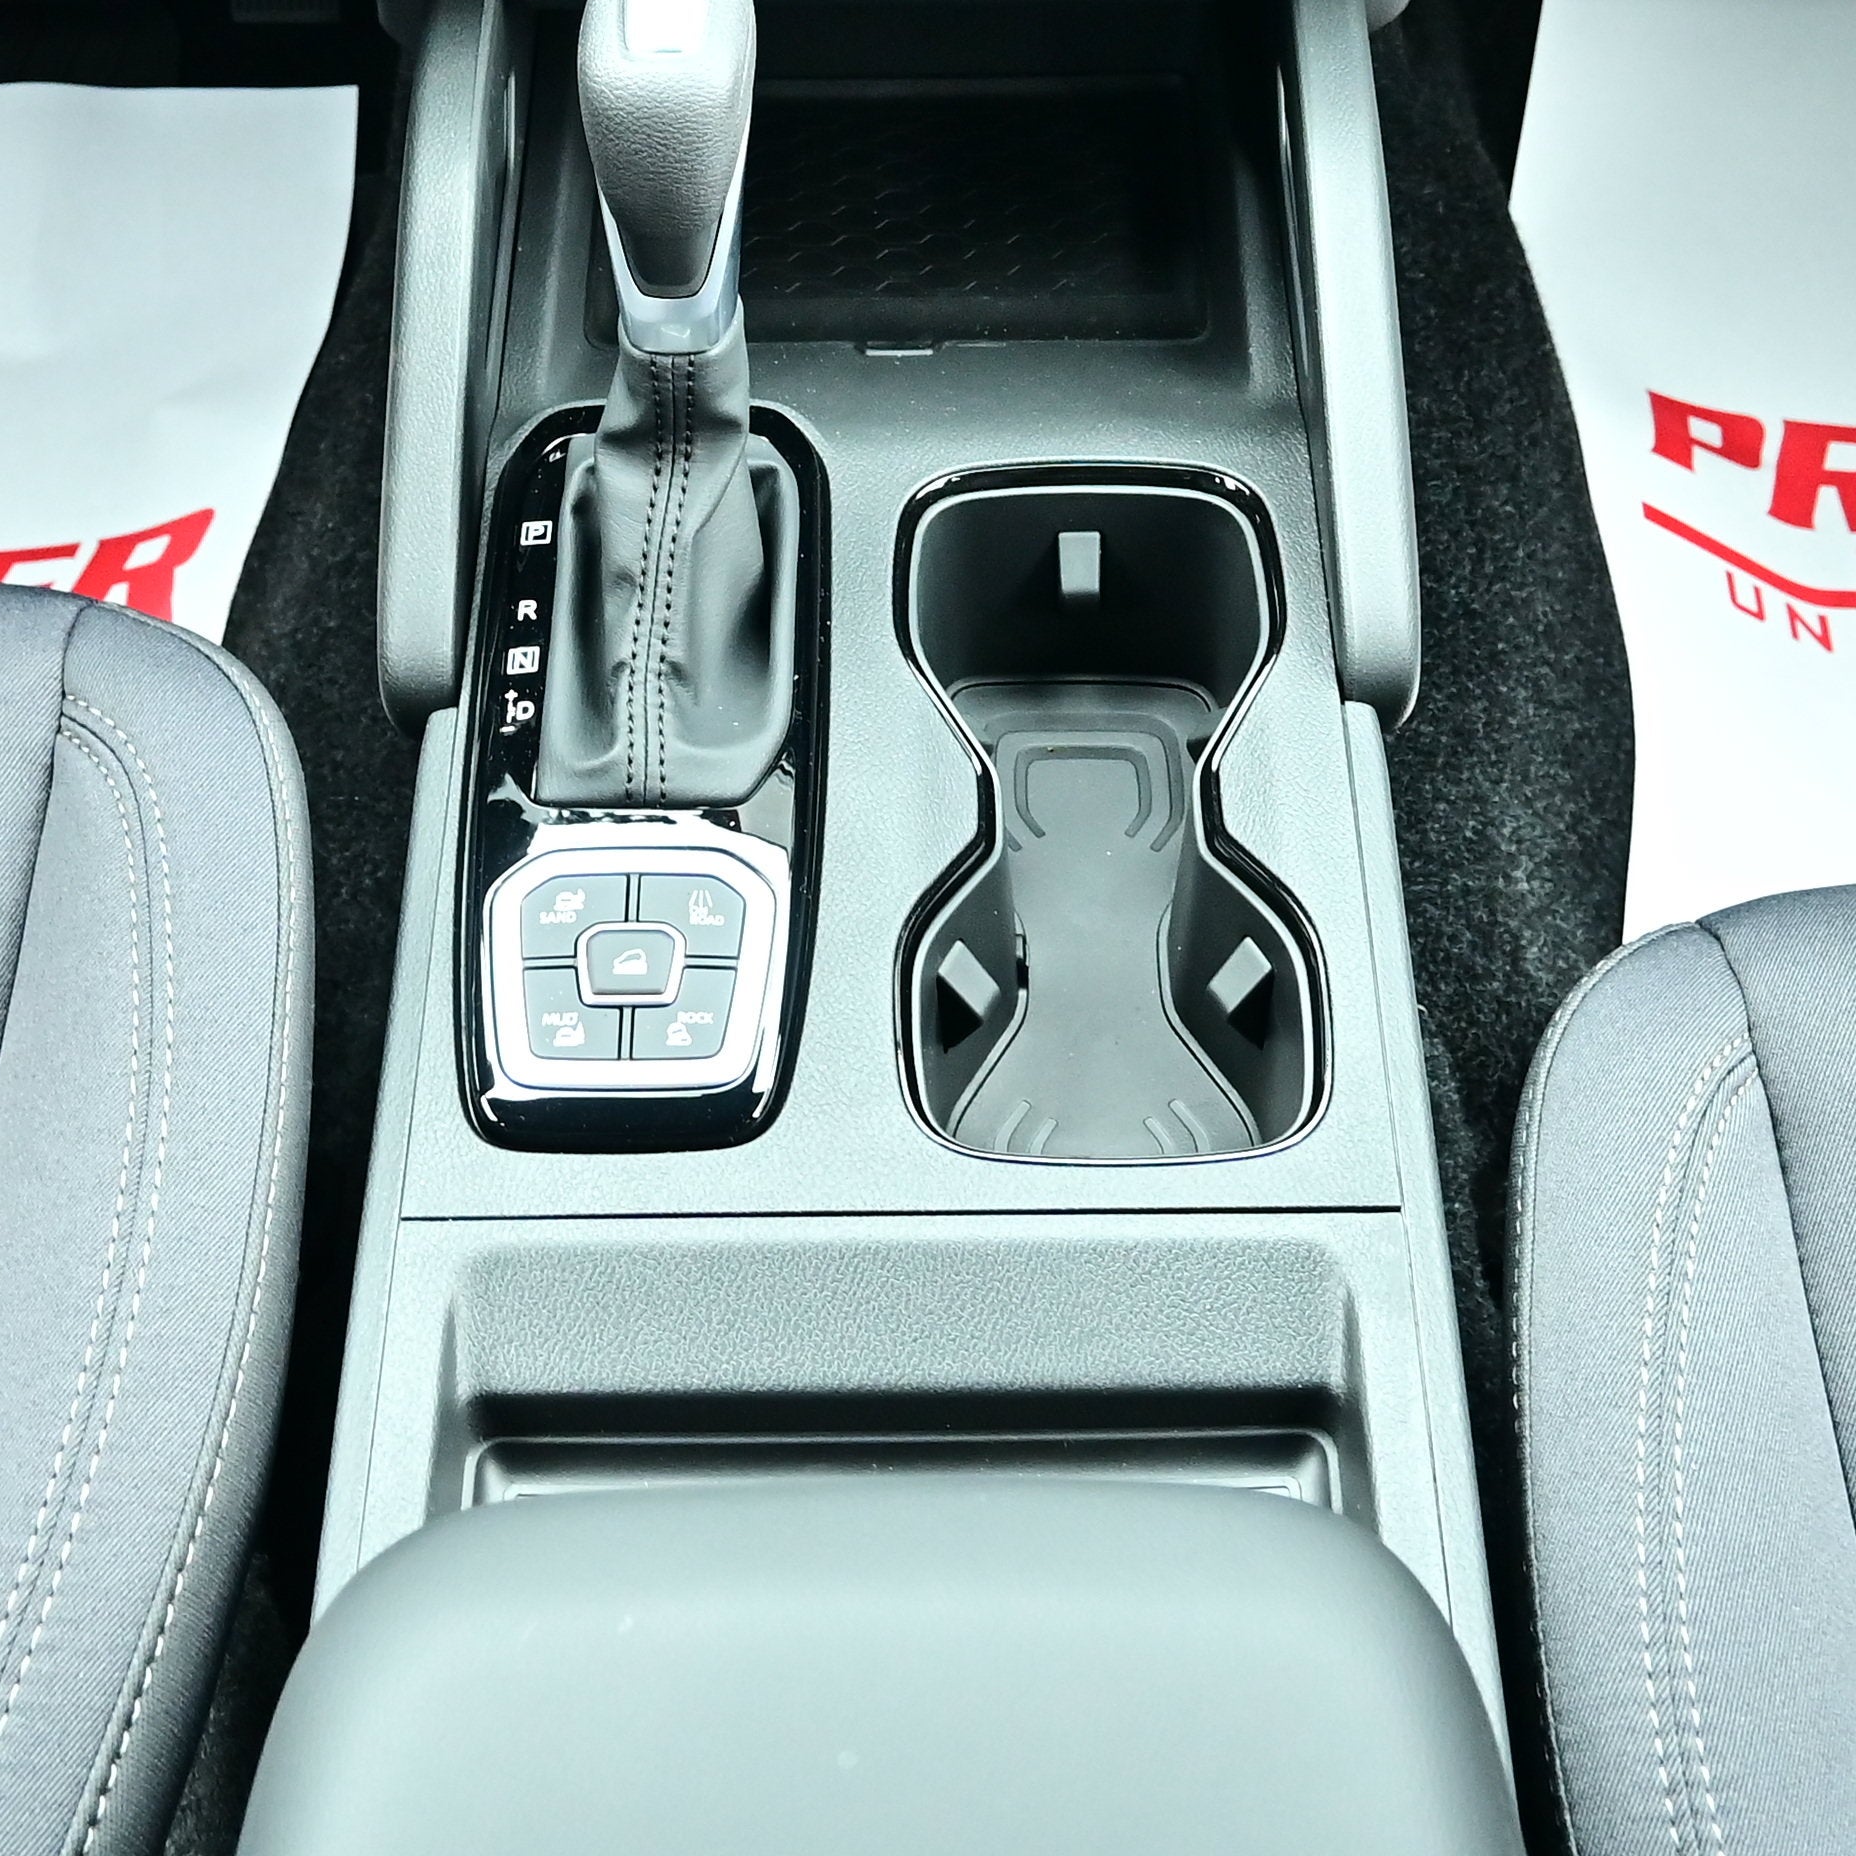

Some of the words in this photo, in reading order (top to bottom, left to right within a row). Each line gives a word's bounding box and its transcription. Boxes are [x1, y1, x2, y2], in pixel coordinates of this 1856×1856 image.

[517, 600, 537, 621] R
[515, 701, 535, 721] D
[539, 911, 577, 925] SAND
[541, 1012, 579, 1026] MUD
[676, 1011, 714, 1024] ROCK
